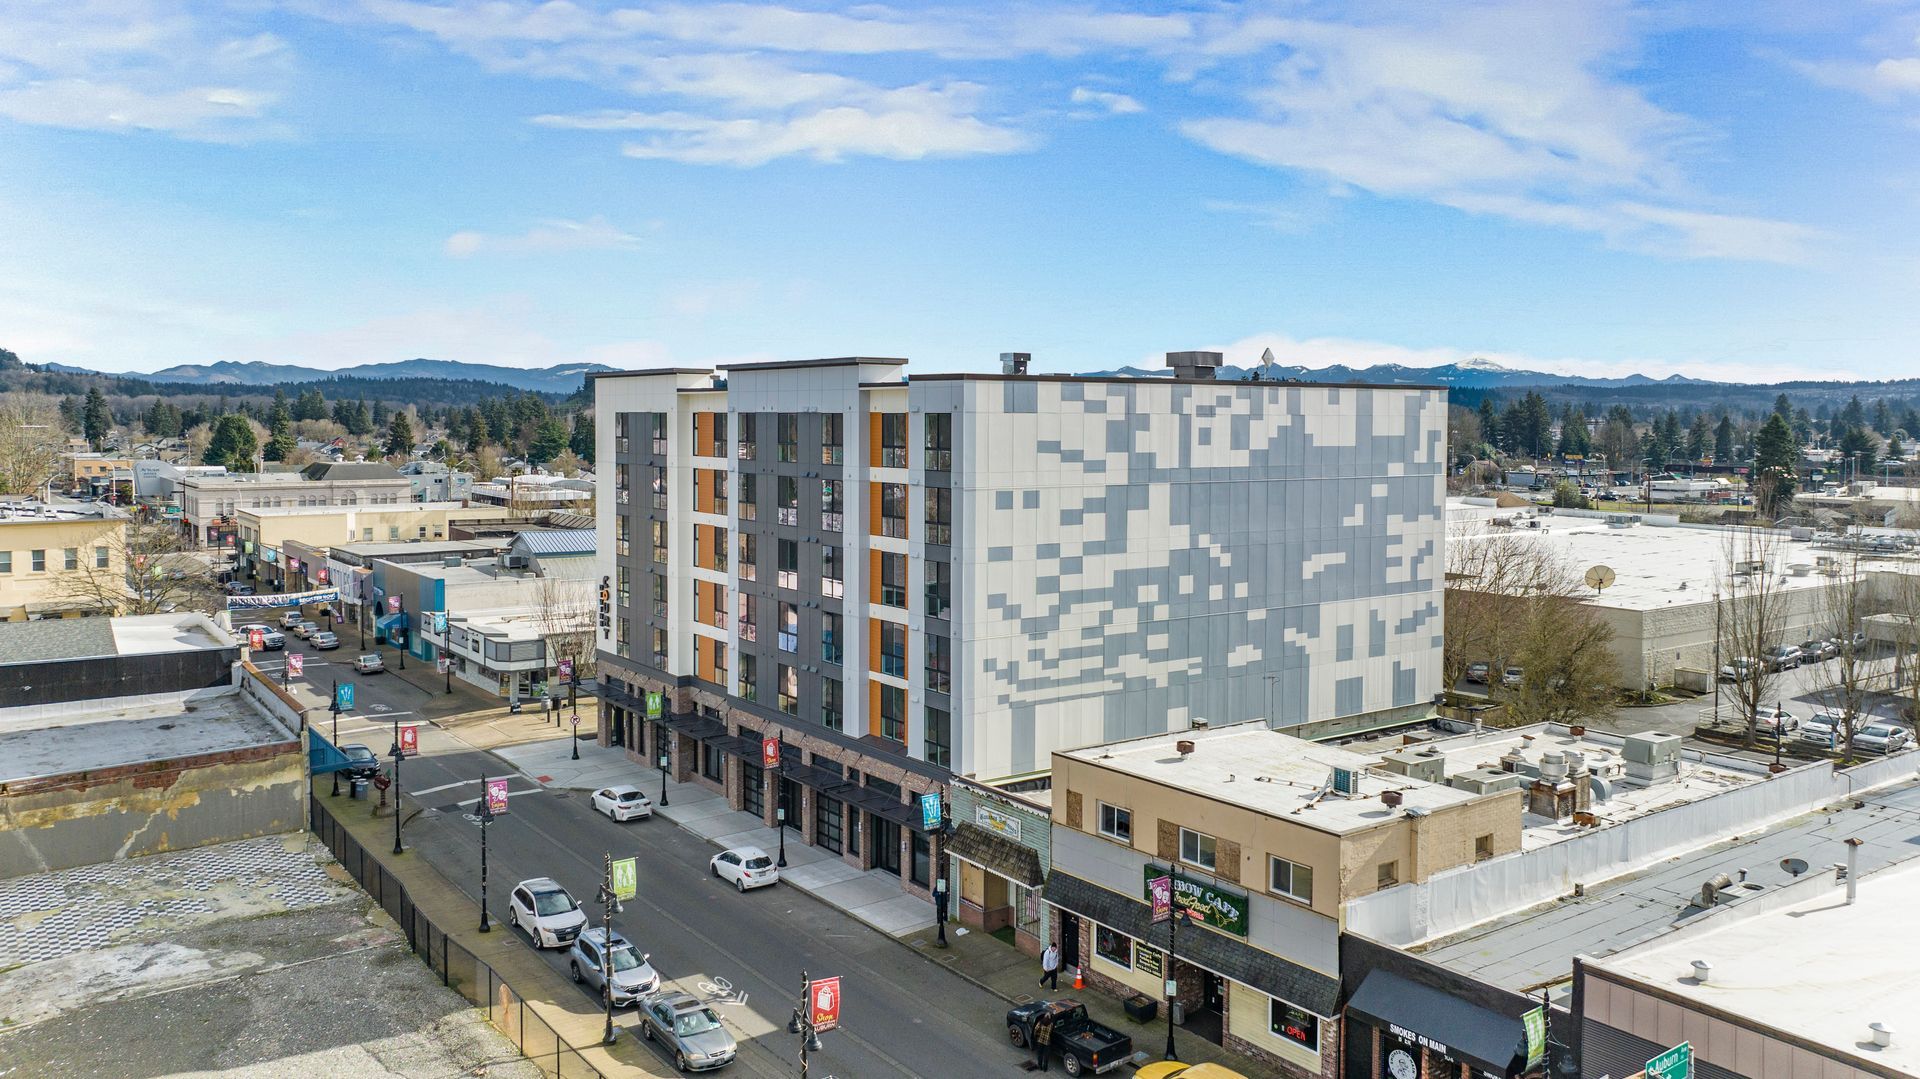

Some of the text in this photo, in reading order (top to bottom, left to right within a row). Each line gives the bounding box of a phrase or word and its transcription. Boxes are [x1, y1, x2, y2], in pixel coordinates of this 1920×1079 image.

[602, 575, 610, 640] COURT
[816, 1012, 833, 1023] Shop
[1286, 1025, 1306, 1041] OPEN
[1389, 1023, 1416, 1042] SMOKES
[1418, 1035, 1429, 1047] ON
[1428, 1039, 1447, 1055] MAIN
[1655, 1053, 1679, 1072] Auburn
